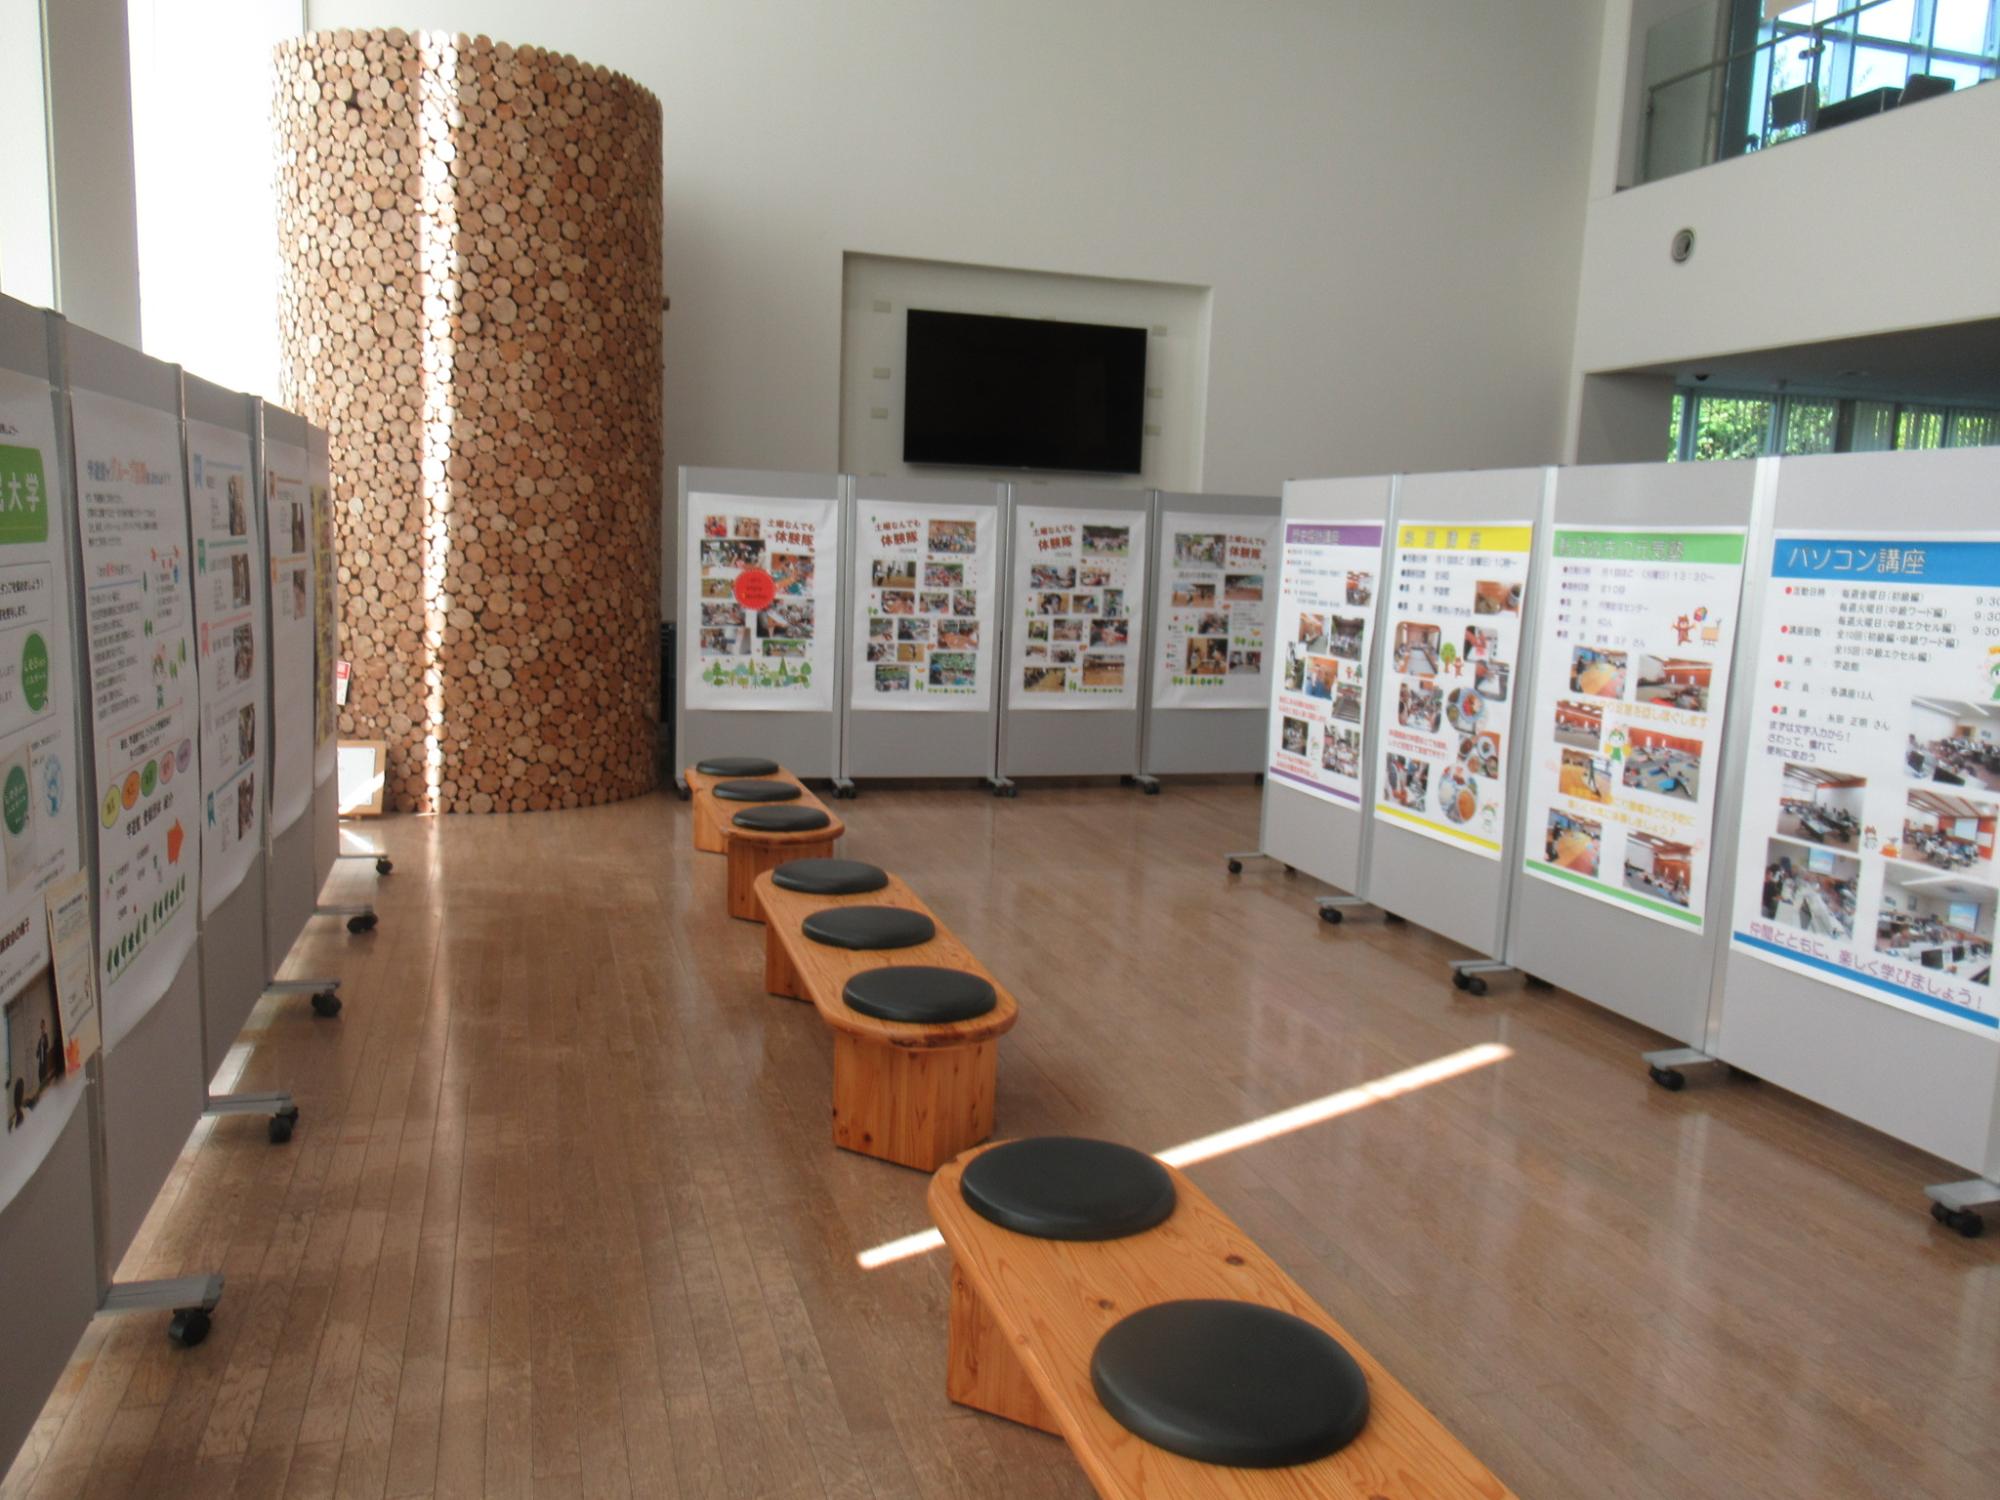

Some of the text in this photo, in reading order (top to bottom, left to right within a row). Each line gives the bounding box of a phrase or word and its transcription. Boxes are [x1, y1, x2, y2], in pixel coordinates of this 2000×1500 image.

[0, 472, 40, 512] 大学
[767, 519, 815, 532] 土曜なんでも
[874, 520, 921, 532] 土曜なんでも
[1033, 525, 1075, 537] 土曜なんでも
[775, 531, 815, 546] 体験隊
[880, 531, 918, 548] 体験隊
[1038, 536, 1073, 551] 体験隊
[1788, 548, 1926, 575] パソコン講座
